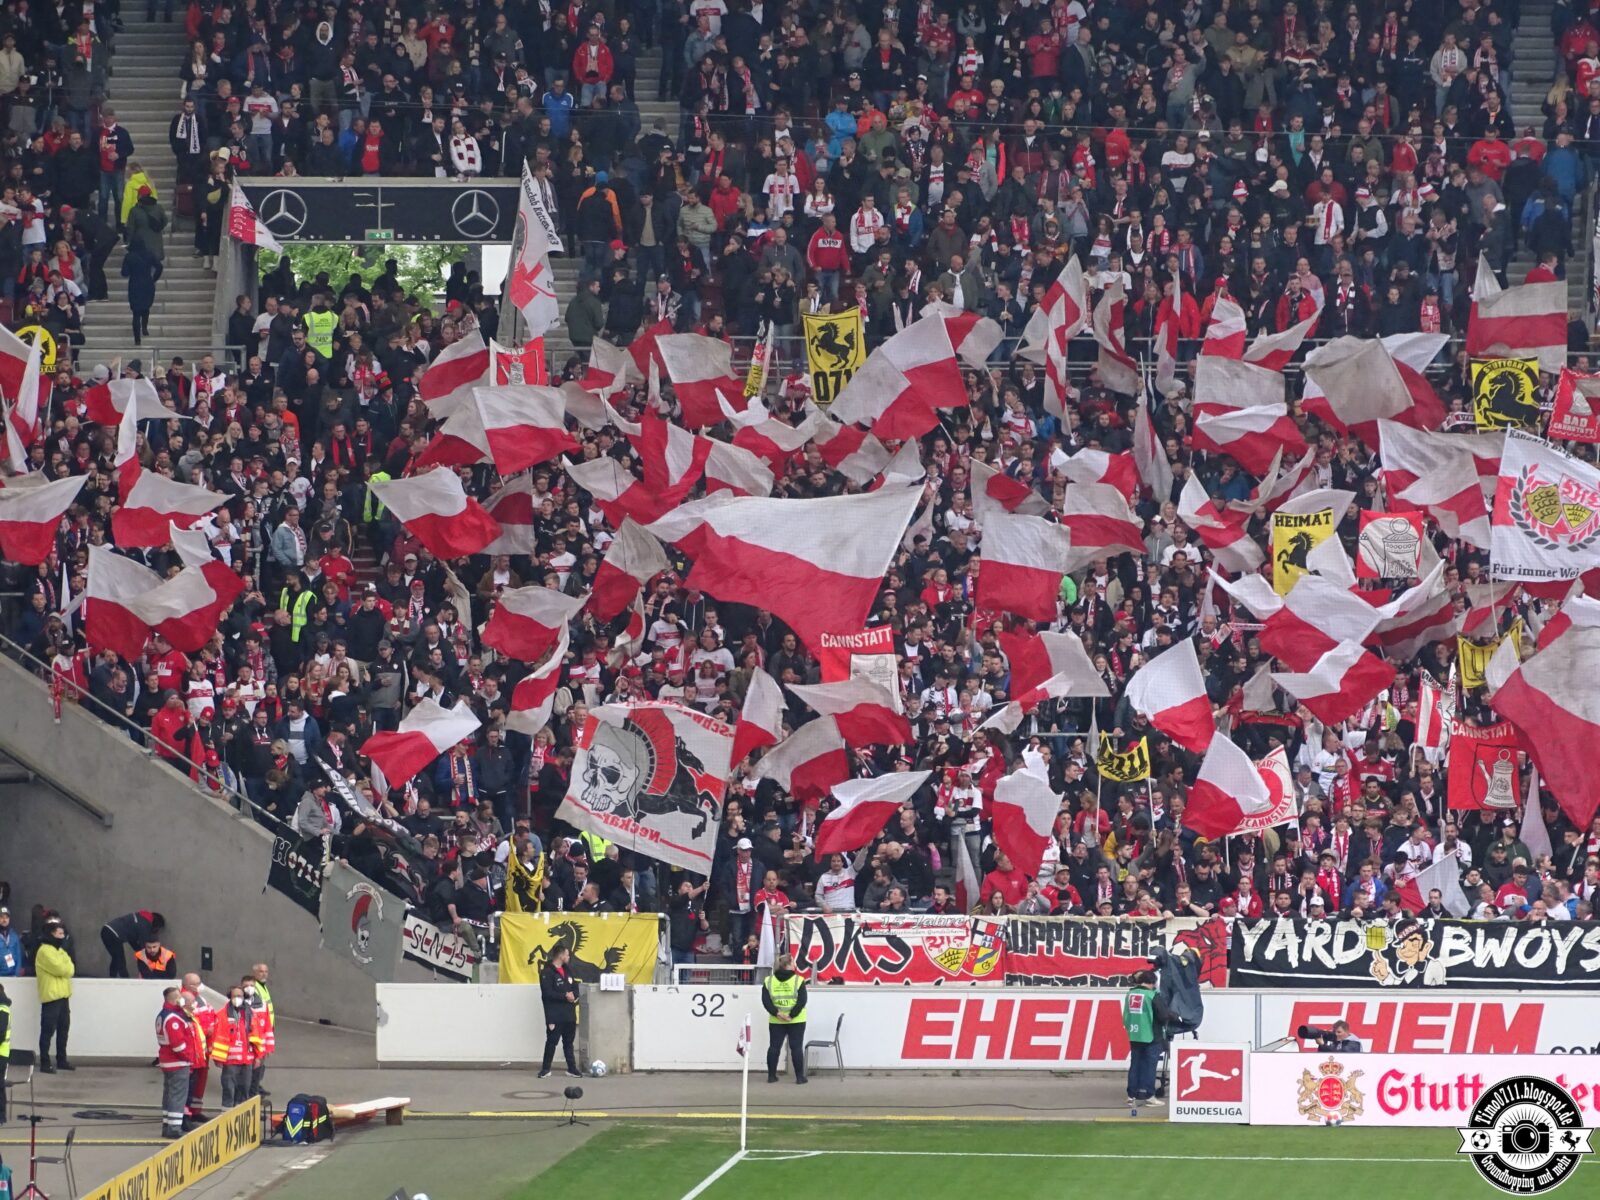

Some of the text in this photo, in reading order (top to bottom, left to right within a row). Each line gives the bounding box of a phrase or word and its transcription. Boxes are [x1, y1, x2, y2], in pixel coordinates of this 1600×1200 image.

[1483, 360, 1527, 374] STUTTGART
[1562, 414, 1589, 427] BAD
[1274, 511, 1333, 528] HEIMAT
[1492, 563, 1515, 576] Für
[1518, 565, 1557, 577] immer
[820, 627, 892, 648] CANNSTATT
[1236, 918, 1367, 969] YARD
[691, 993, 725, 1018] 32
[1287, 1000, 1545, 1054] EHEIM
[1176, 1106, 1243, 1116] BUNDESLIGA
[232, 1103, 256, 1151] SWR1
[197, 1123, 220, 1172] SWR1
[162, 1144, 185, 1195] SWR1
